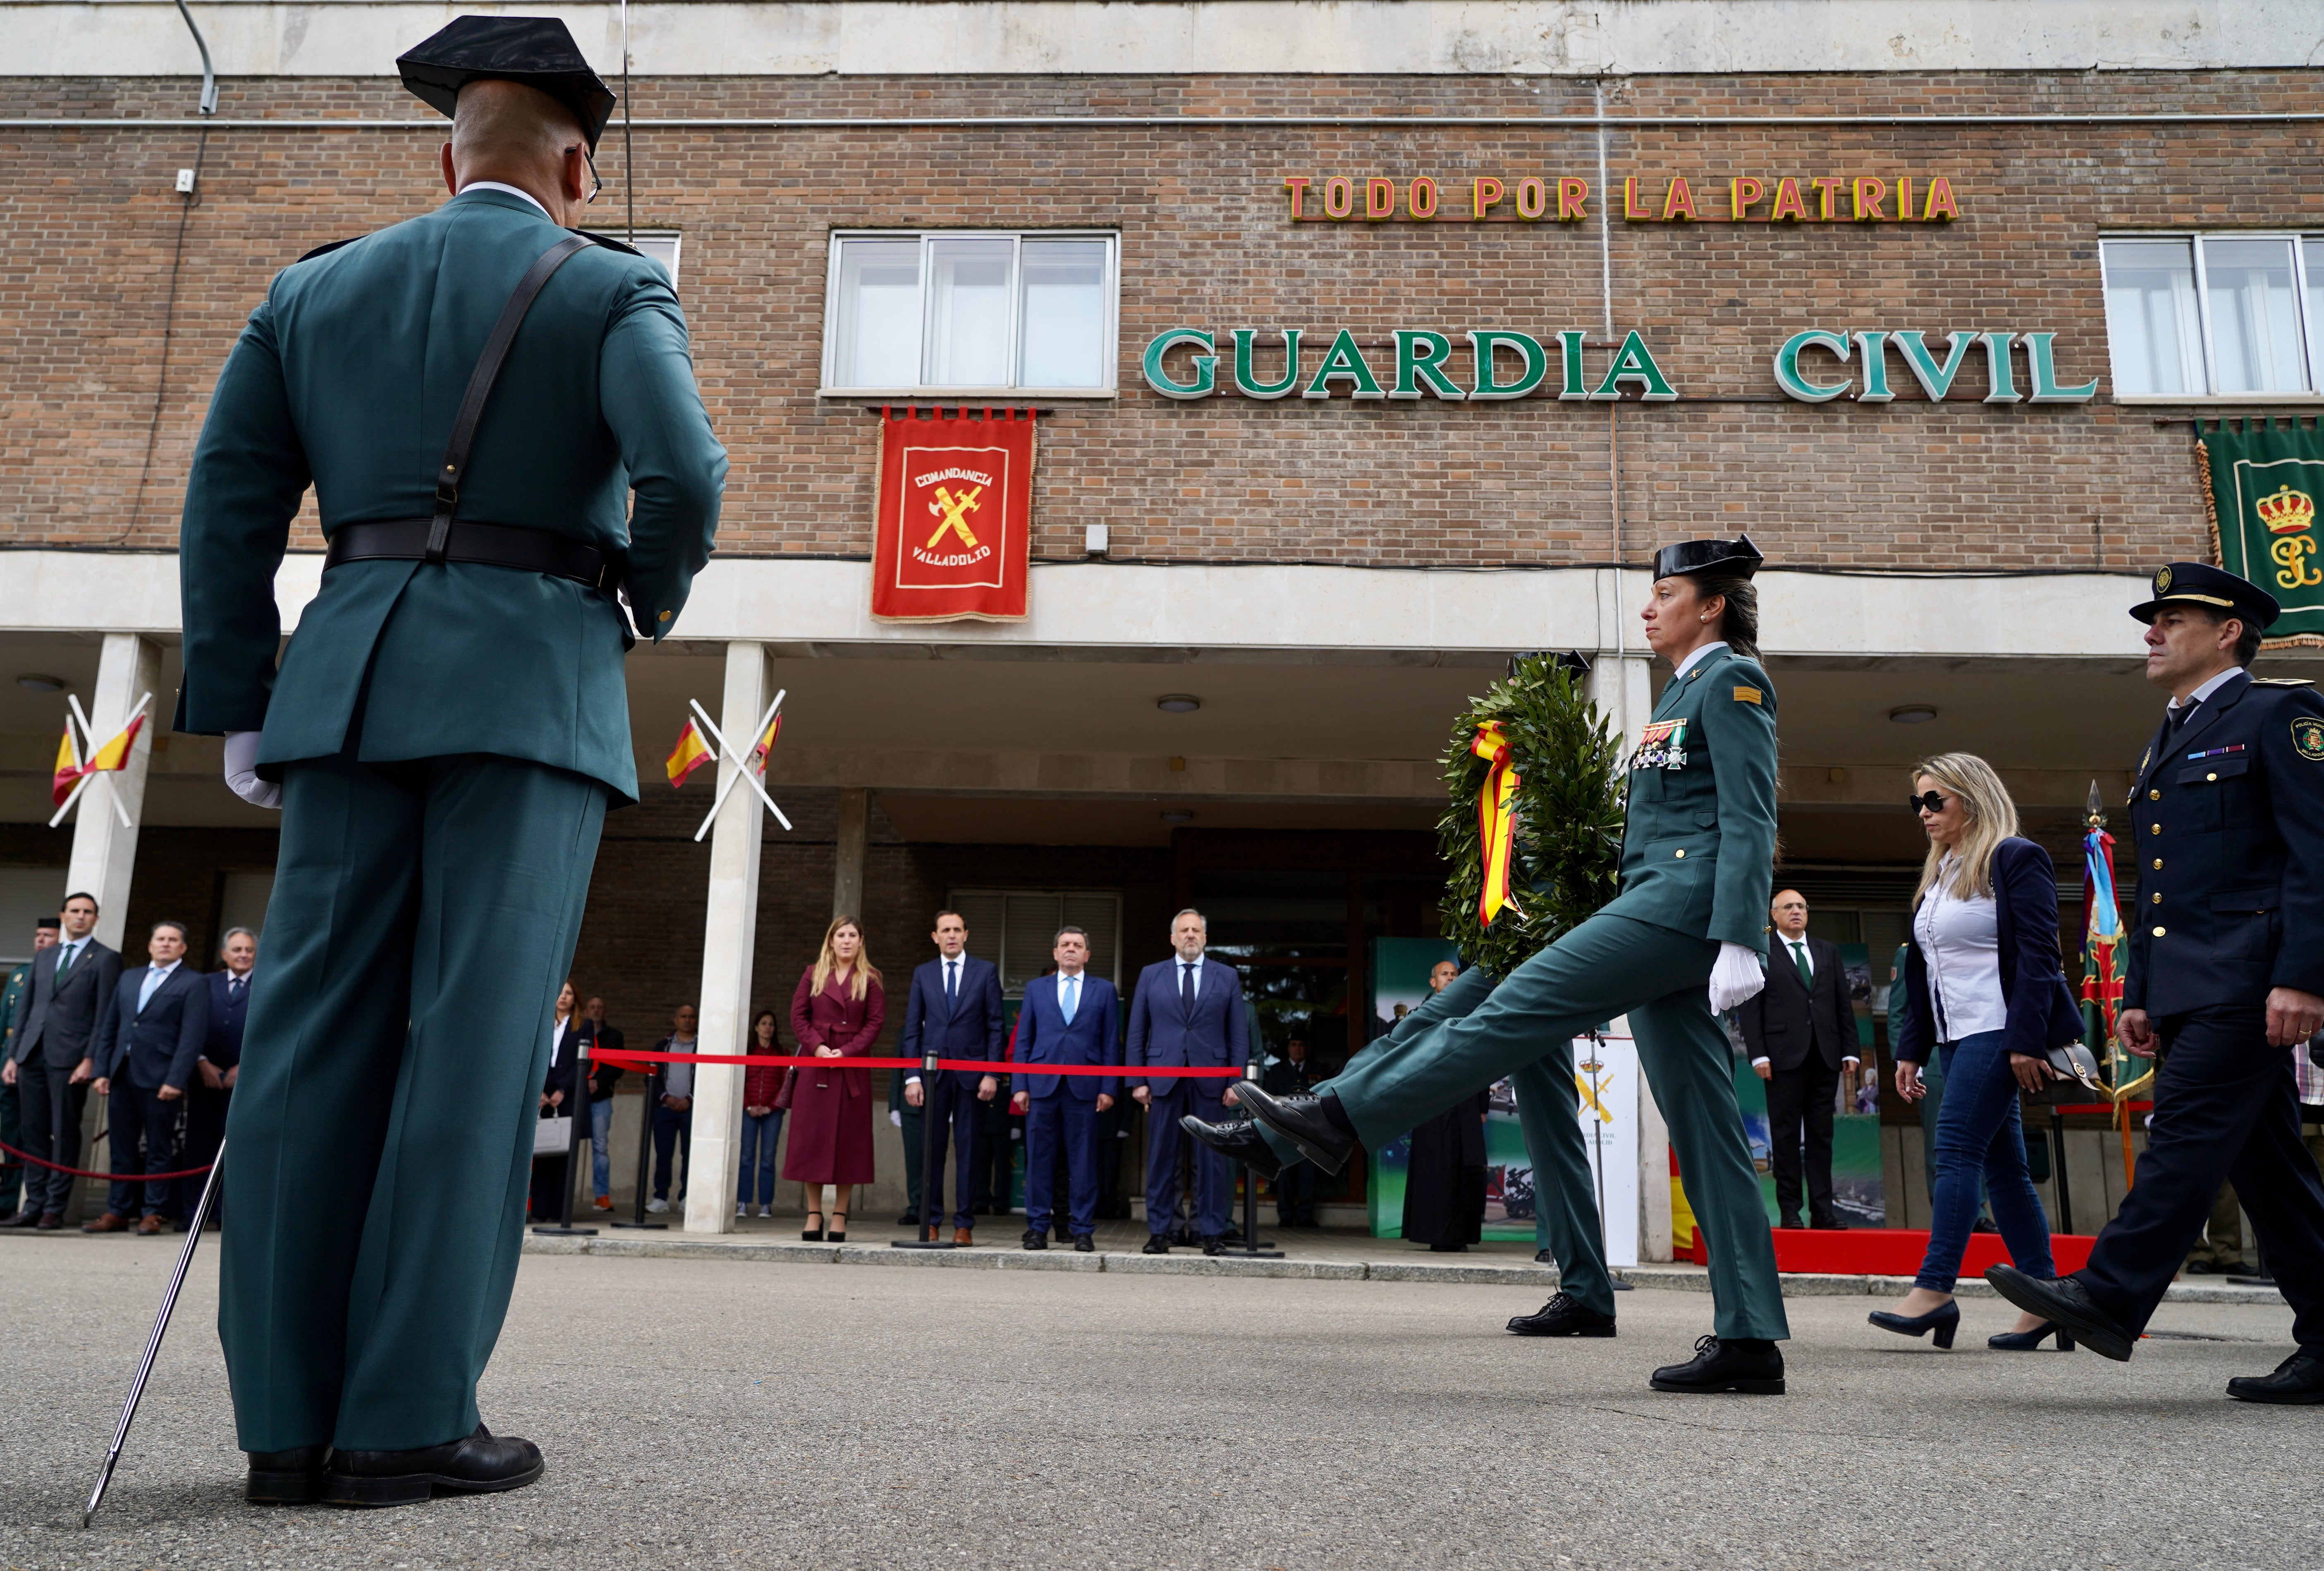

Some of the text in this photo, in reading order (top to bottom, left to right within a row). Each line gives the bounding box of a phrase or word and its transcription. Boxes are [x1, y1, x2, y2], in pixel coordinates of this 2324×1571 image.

[1284, 176, 1959, 222] TODO POR LA PATRIA
[1143, 328, 2099, 403] GUARDIA CIVIL
[915, 468, 992, 487] COMANDANCIA
[913, 546, 991, 566] VALLADOLID
